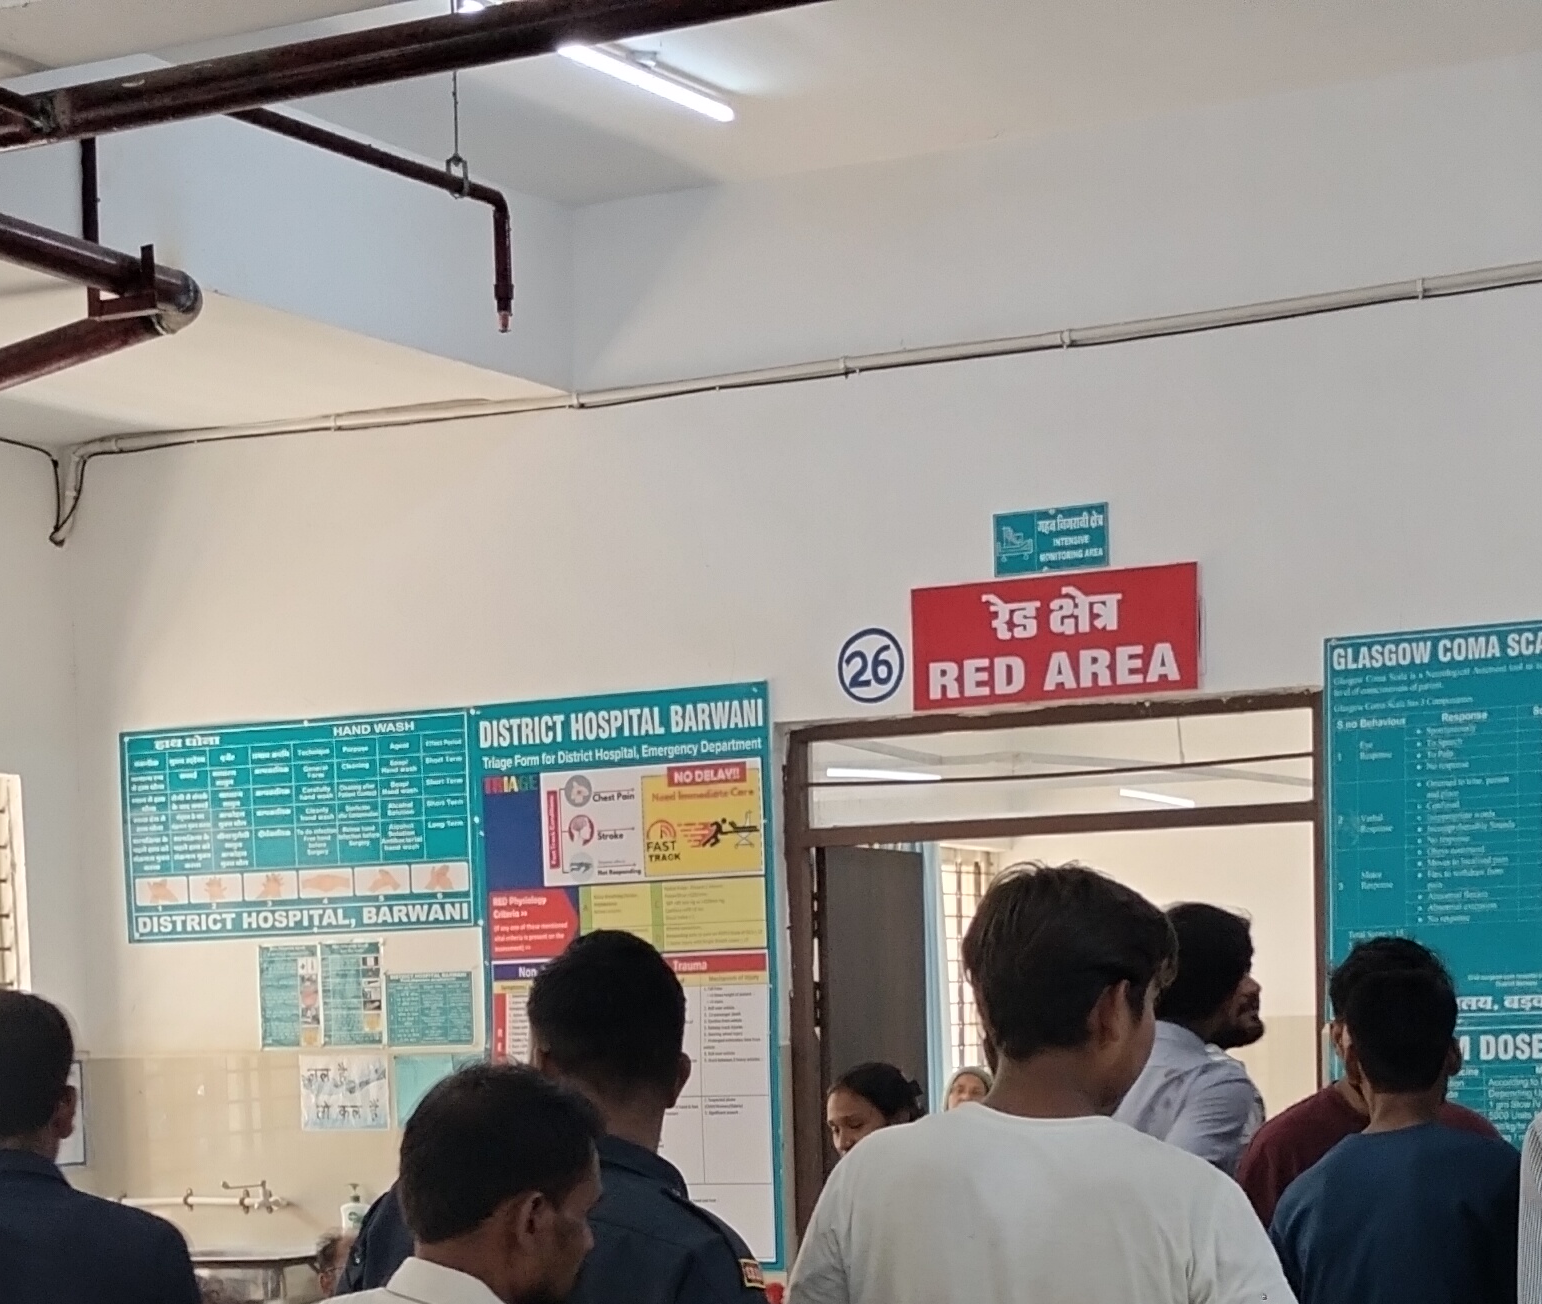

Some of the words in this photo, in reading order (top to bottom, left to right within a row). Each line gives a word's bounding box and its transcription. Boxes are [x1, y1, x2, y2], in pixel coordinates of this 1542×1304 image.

[1084, 548, 1103, 557] AREA
[981, 593, 1041, 641] रेड
[1049, 585, 1123, 635] क्षेत्र
[1332, 641, 1431, 671] GLASGOW
[1438, 635, 1500, 662] COMA
[845, 644, 893, 689] 26
[929, 655, 1025, 700] RED
[1043, 643, 1180, 691] AREA
[479, 714, 564, 748] DISTRICT
[570, 706, 664, 741] HOSPITAL
[670, 698, 764, 734] BARWANI
[1360, 718, 1406, 728] Behaviour
[1442, 711, 1488, 723] Response
[334, 725, 371, 737] HAND
[373, 721, 415, 734] WASH
[154, 739, 182, 750] हाथ
[185, 735, 220, 747] धोना
[482, 755, 513, 771] Triage
[514, 754, 539, 766] Form
[541, 752, 556, 765] for
[558, 750, 593, 764] District
[595, 745, 640, 762] Hospital,
[641, 742, 699, 759] Emergency
[701, 737, 762, 755] Department
[674, 768, 693, 783] NO
[484, 774, 538, 794] TRIAGE
[592, 794, 615, 802] Chest
[617, 791, 635, 800] Pain
[597, 830, 624, 840] Stroke
[647, 841, 677, 851] FAST
[649, 853, 681, 861] TRACK
[493, 897, 508, 906] RED
[138, 913, 236, 934] DISTRICT
[243, 907, 356, 930] HOSPITAL,
[363, 902, 469, 924] BARWANI
[673, 958, 707, 971] Trauma
[338, 1104, 362, 1120] कल
